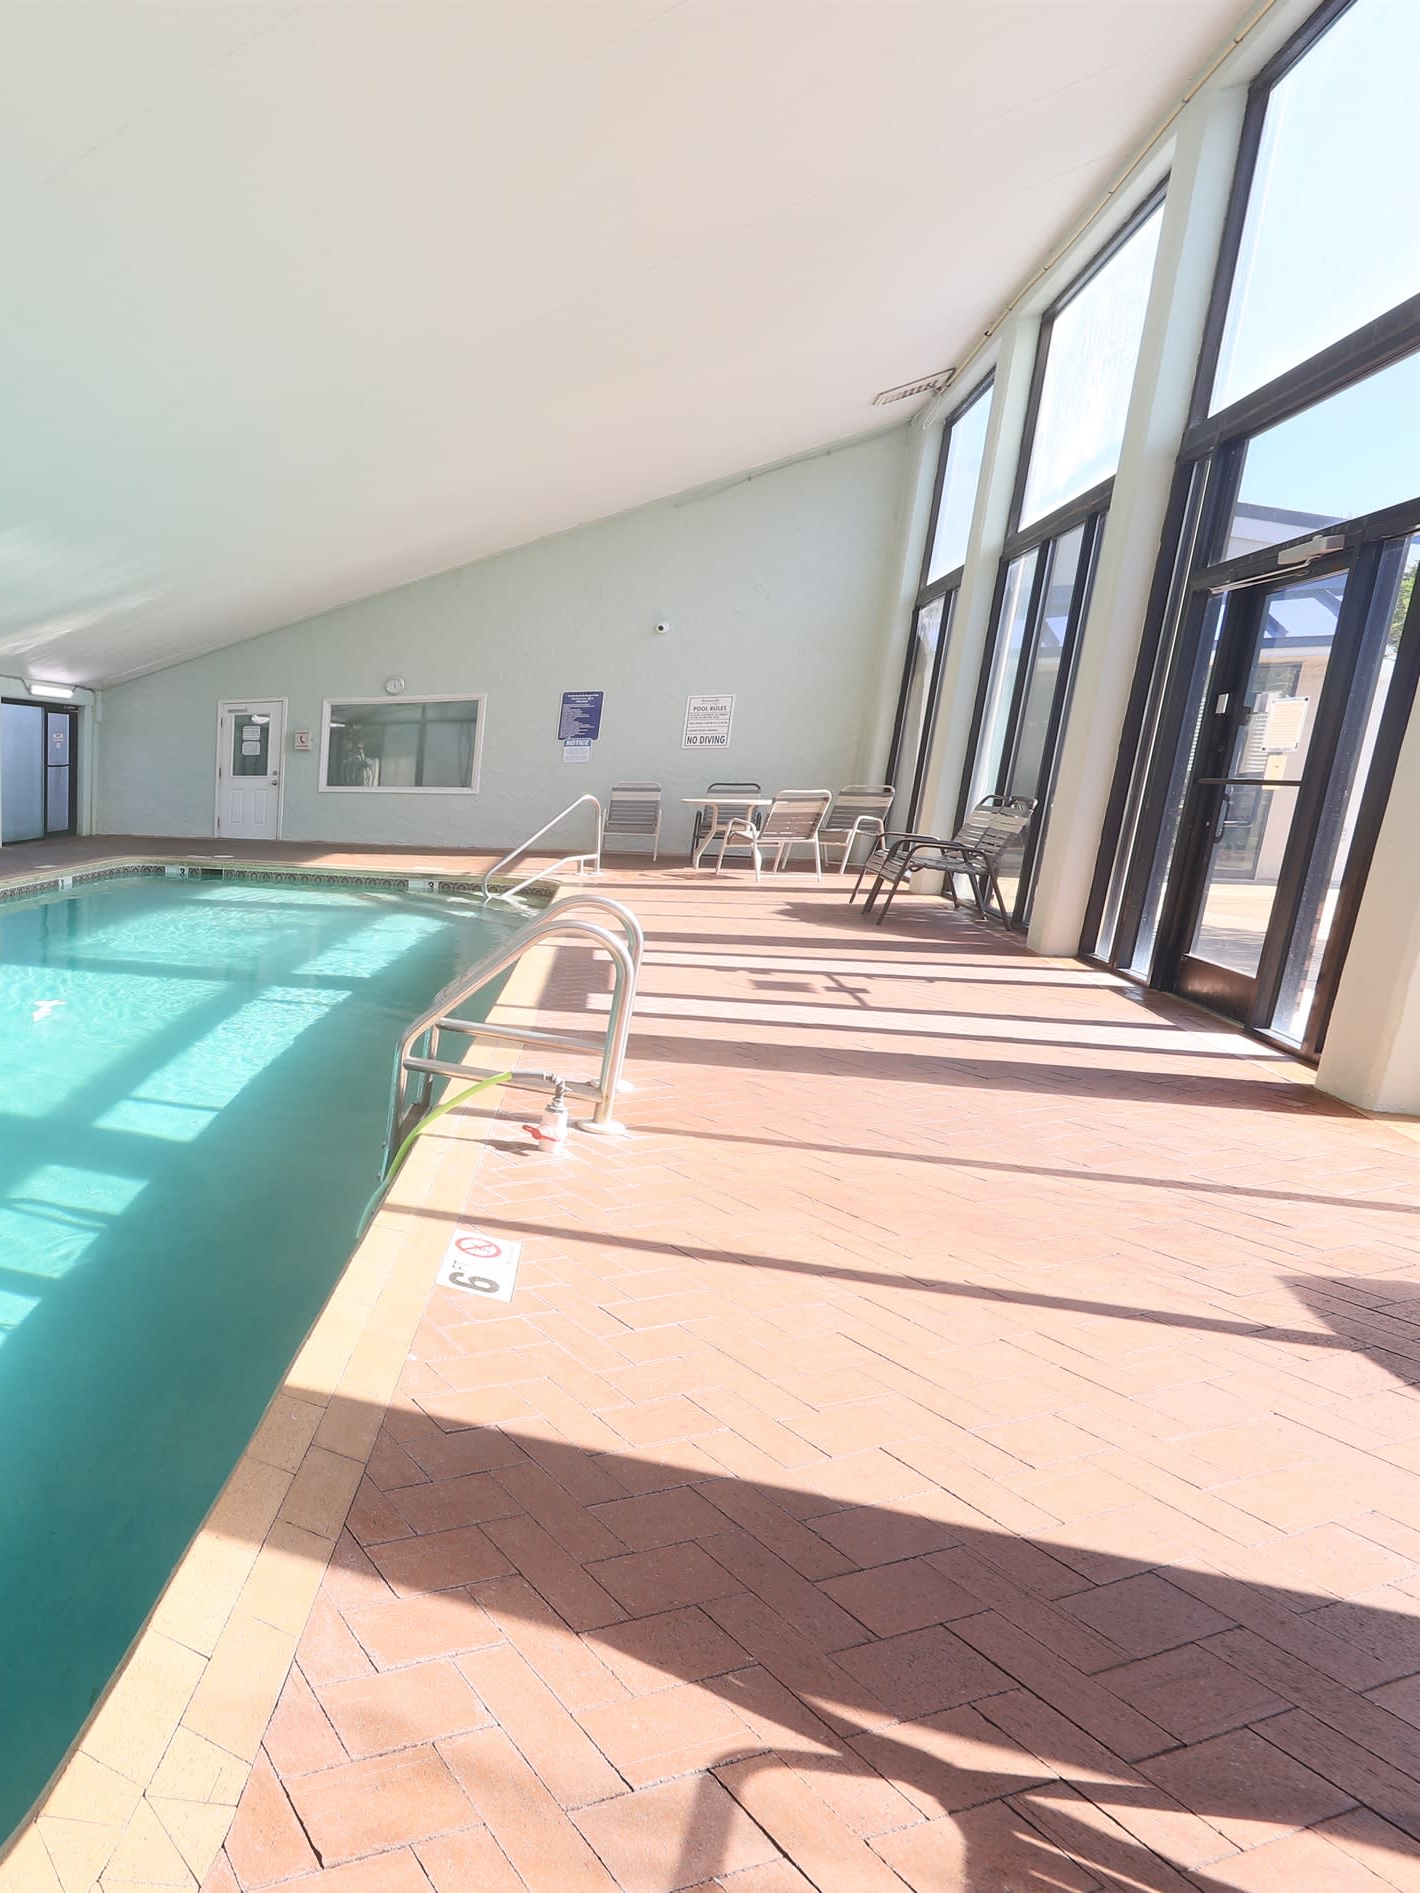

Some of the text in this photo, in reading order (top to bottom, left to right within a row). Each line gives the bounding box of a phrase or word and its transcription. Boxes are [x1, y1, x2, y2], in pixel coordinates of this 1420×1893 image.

[687, 735, 725, 744] NO DIVING
[448, 1271, 500, 1293] 6
